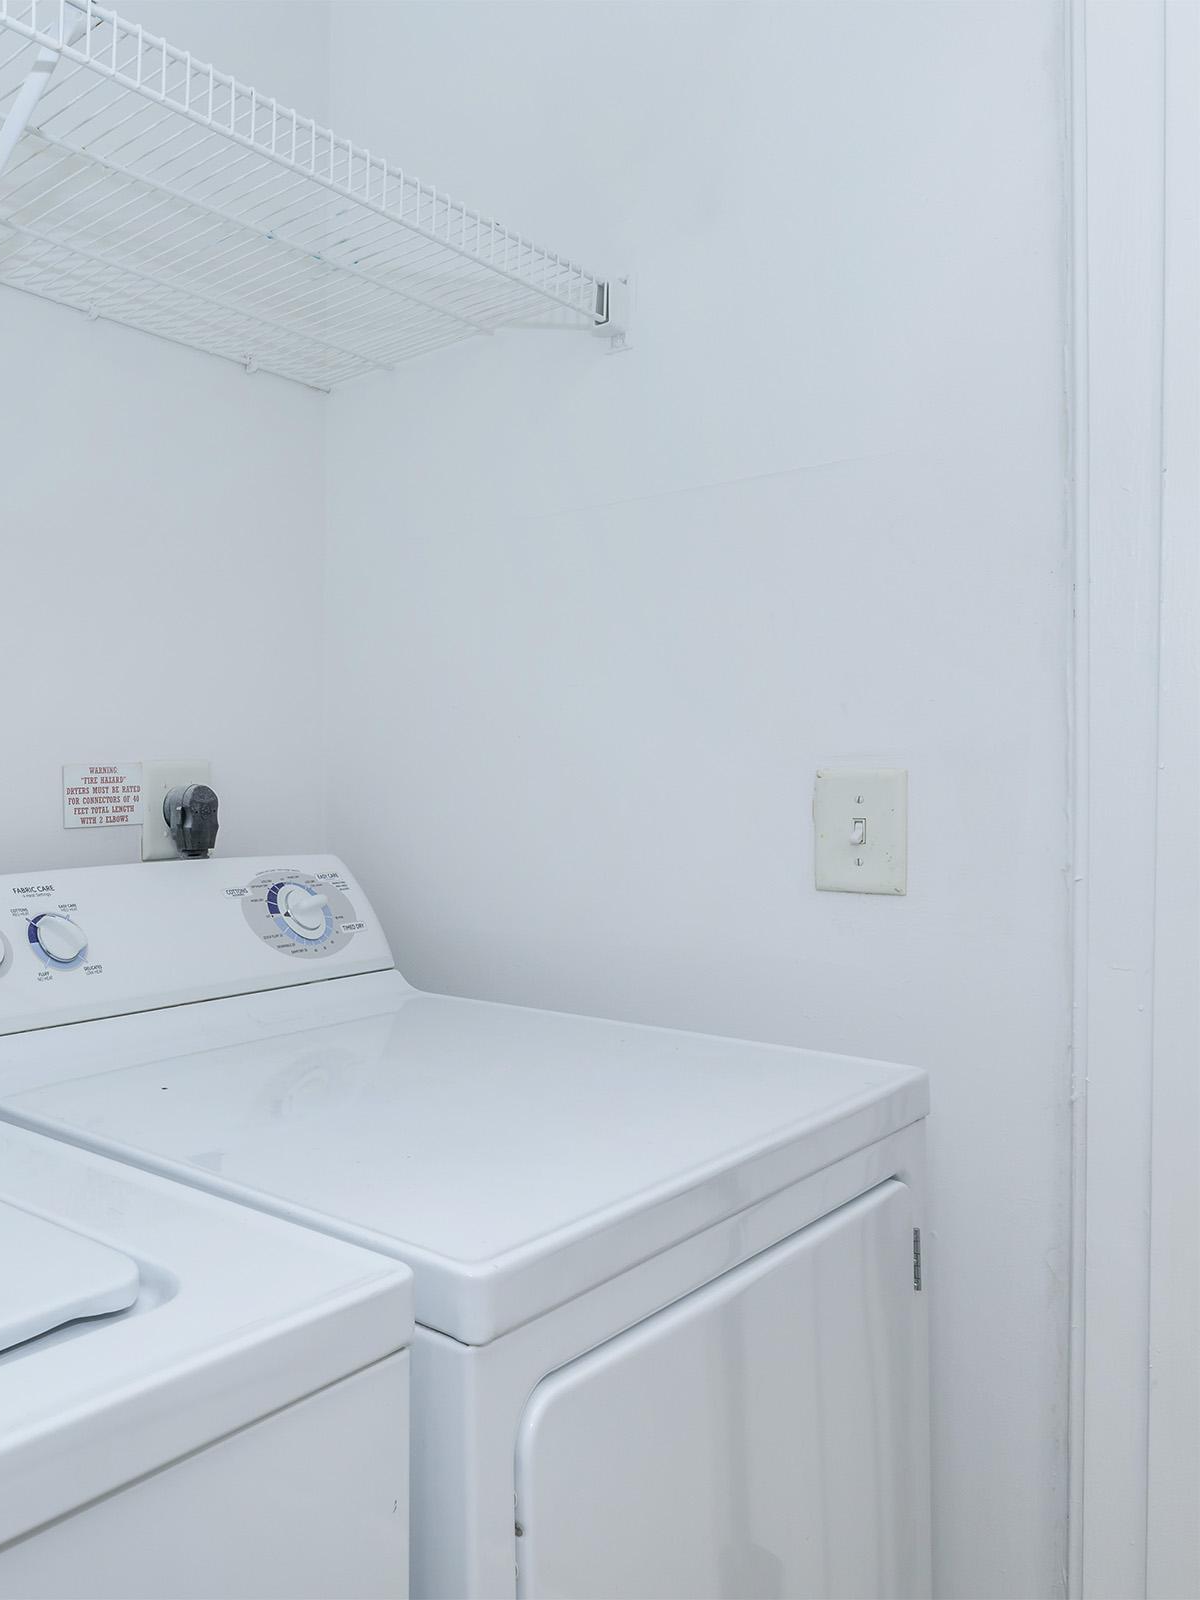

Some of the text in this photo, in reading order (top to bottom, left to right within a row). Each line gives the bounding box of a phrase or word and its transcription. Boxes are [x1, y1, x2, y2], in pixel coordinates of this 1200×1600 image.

[66, 787, 90, 795] DRYERS
[92, 786, 109, 794] MUST
[122, 785, 141, 793] RATED
[82, 796, 120, 804] CONNECTORS
[91, 806, 109, 814] TOTAL
[112, 805, 134, 813] LENGTH
[106, 815, 129, 823] ELBOWS
[12, 886, 36, 894] FABRIC
